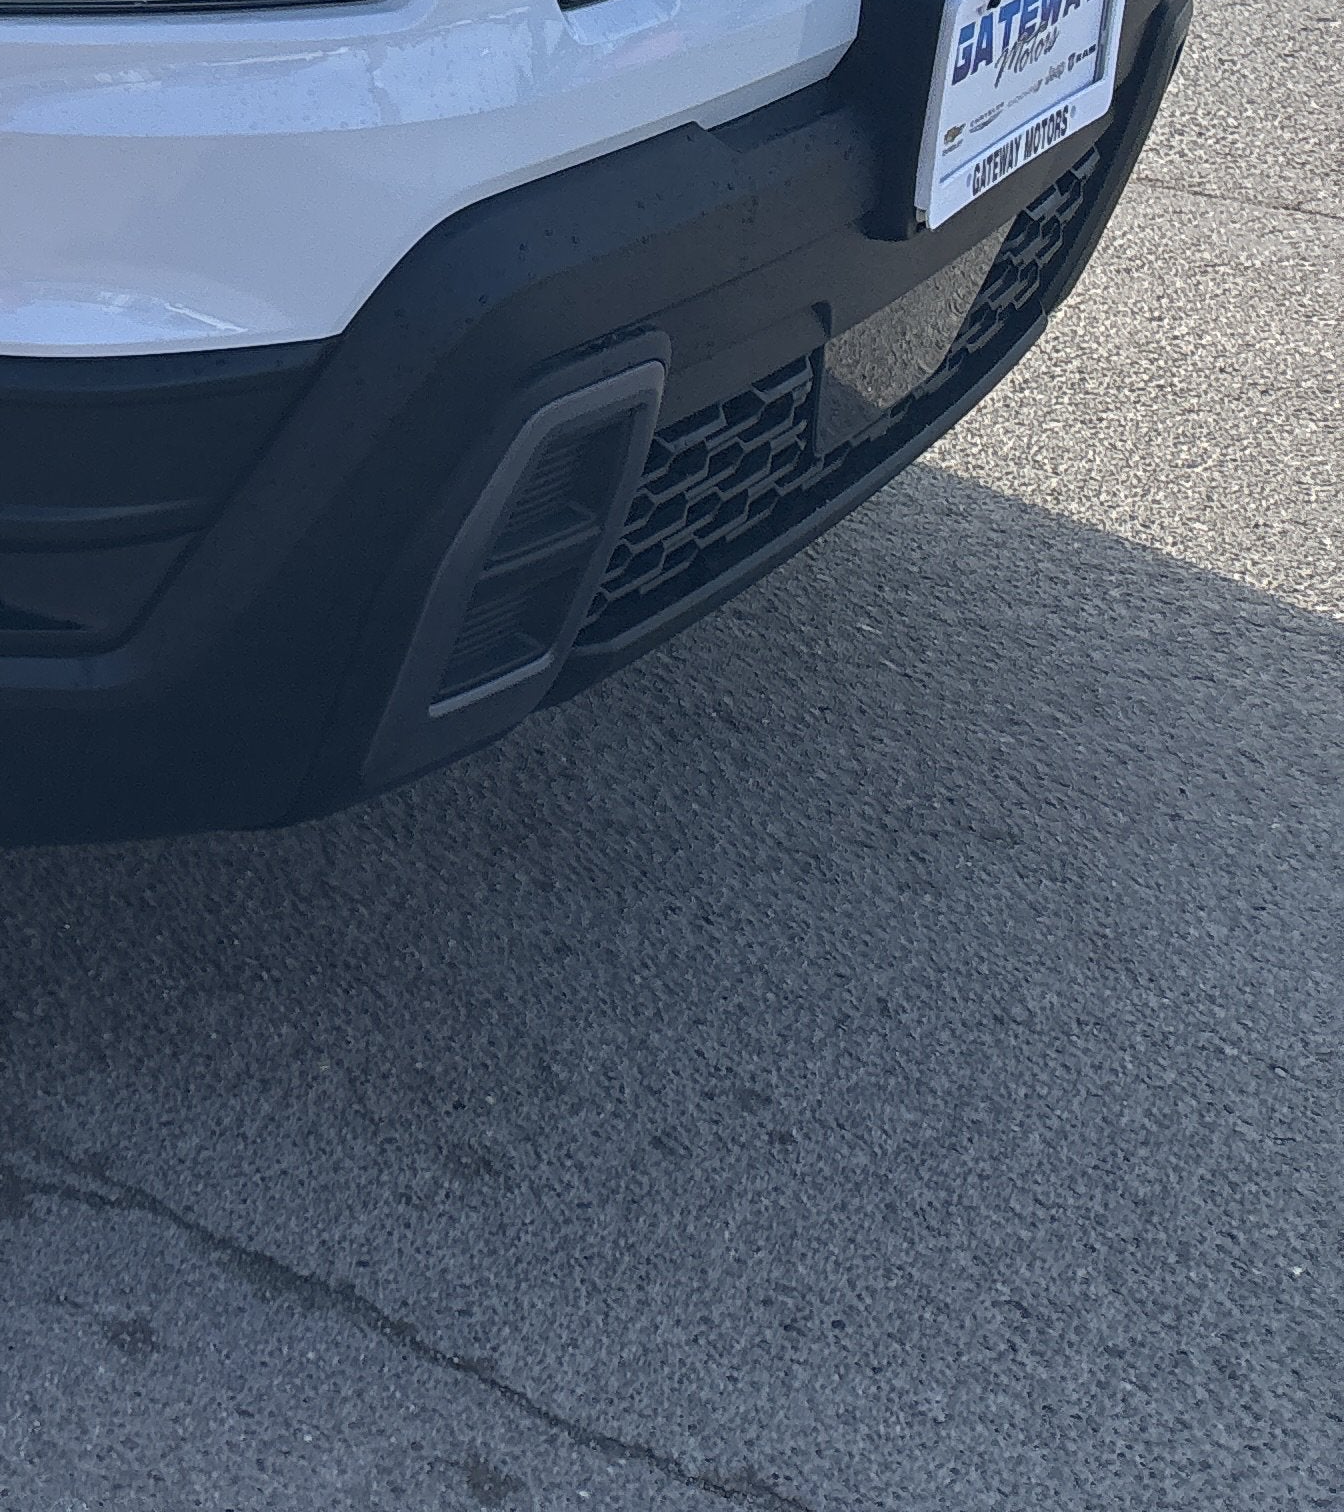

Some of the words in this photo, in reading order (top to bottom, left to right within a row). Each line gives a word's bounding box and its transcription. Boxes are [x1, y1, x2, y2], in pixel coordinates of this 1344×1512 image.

[994, 20, 1060, 88] Motors
[972, 135, 1022, 196] GATEWAY
[1024, 104, 1069, 160] MOTORS
